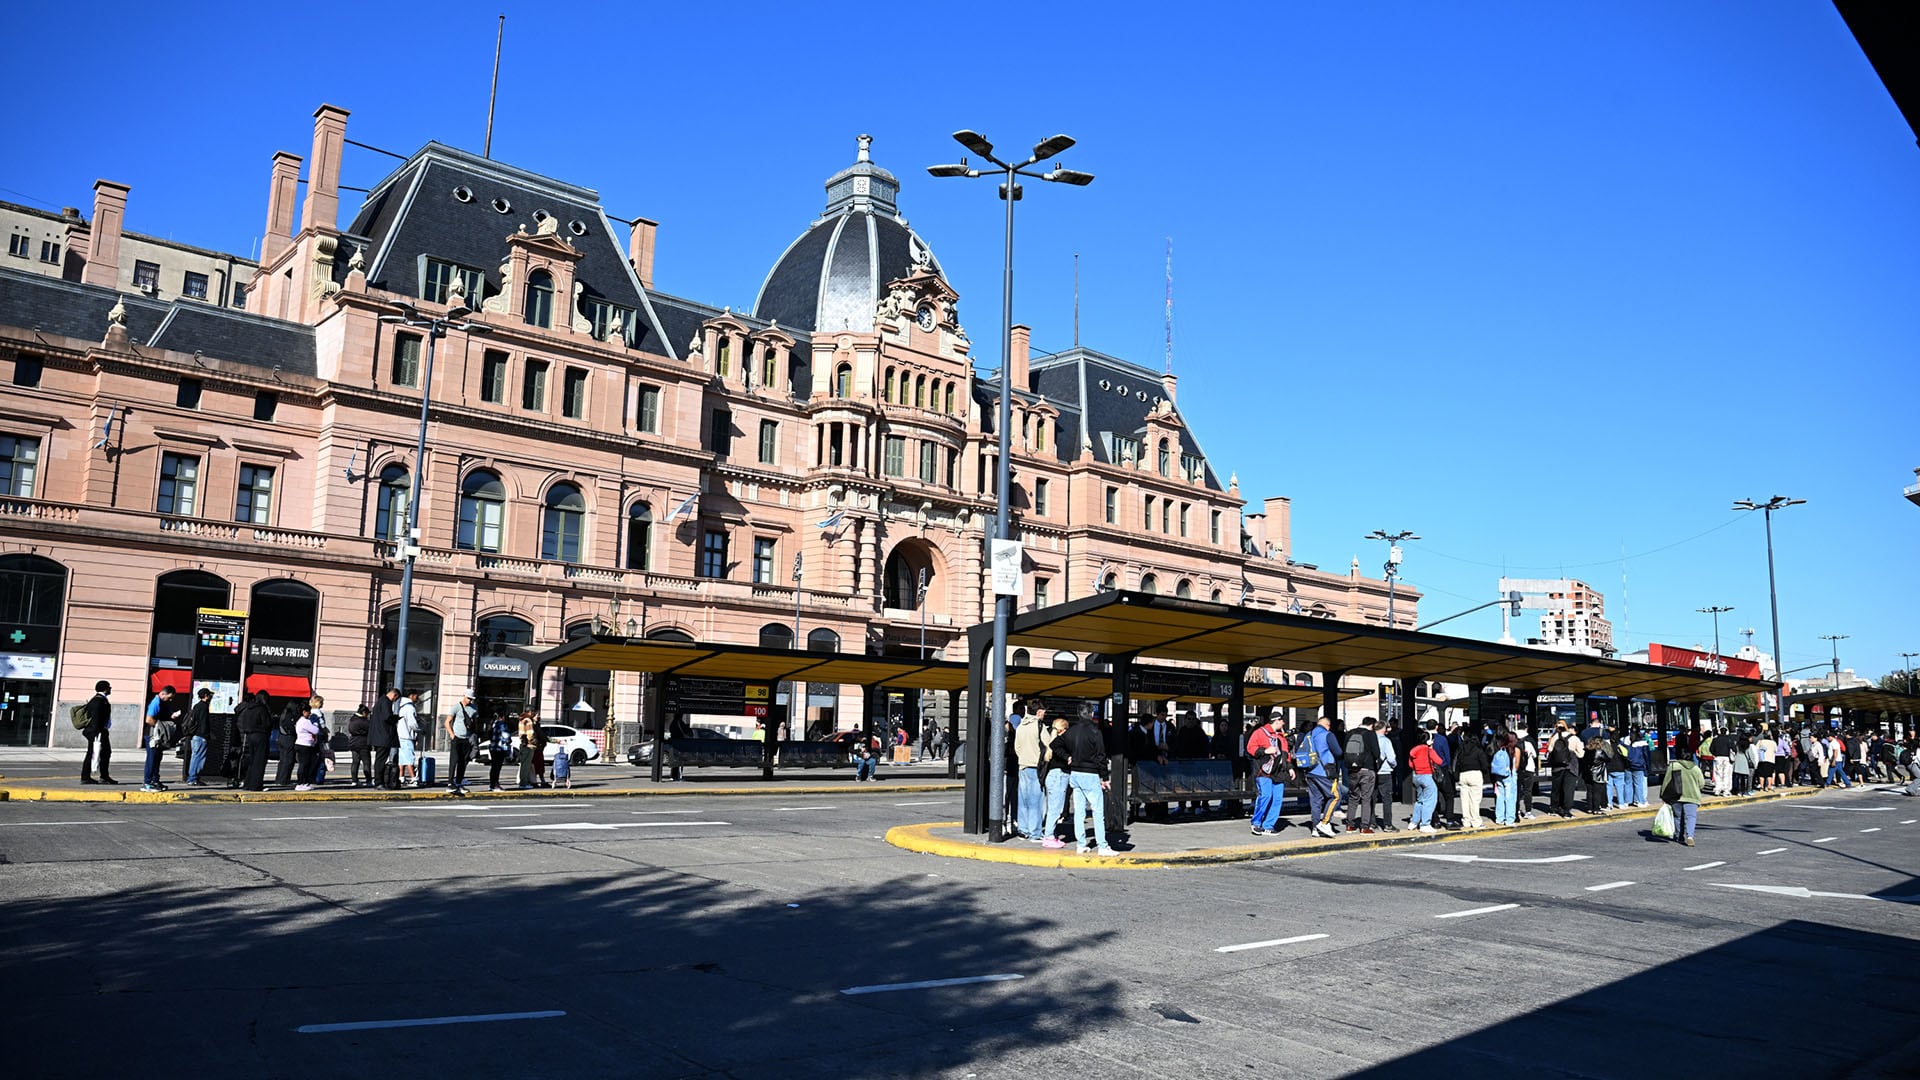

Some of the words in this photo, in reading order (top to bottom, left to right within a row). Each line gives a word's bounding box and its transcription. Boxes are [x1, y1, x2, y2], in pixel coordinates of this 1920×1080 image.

[261, 646, 284, 656] PAPAS
[285, 647, 309, 658] FRITAS
[757, 688, 767, 696] 98
[1220, 685, 1232, 695] 143
[223, 717, 233, 759] nstitución
